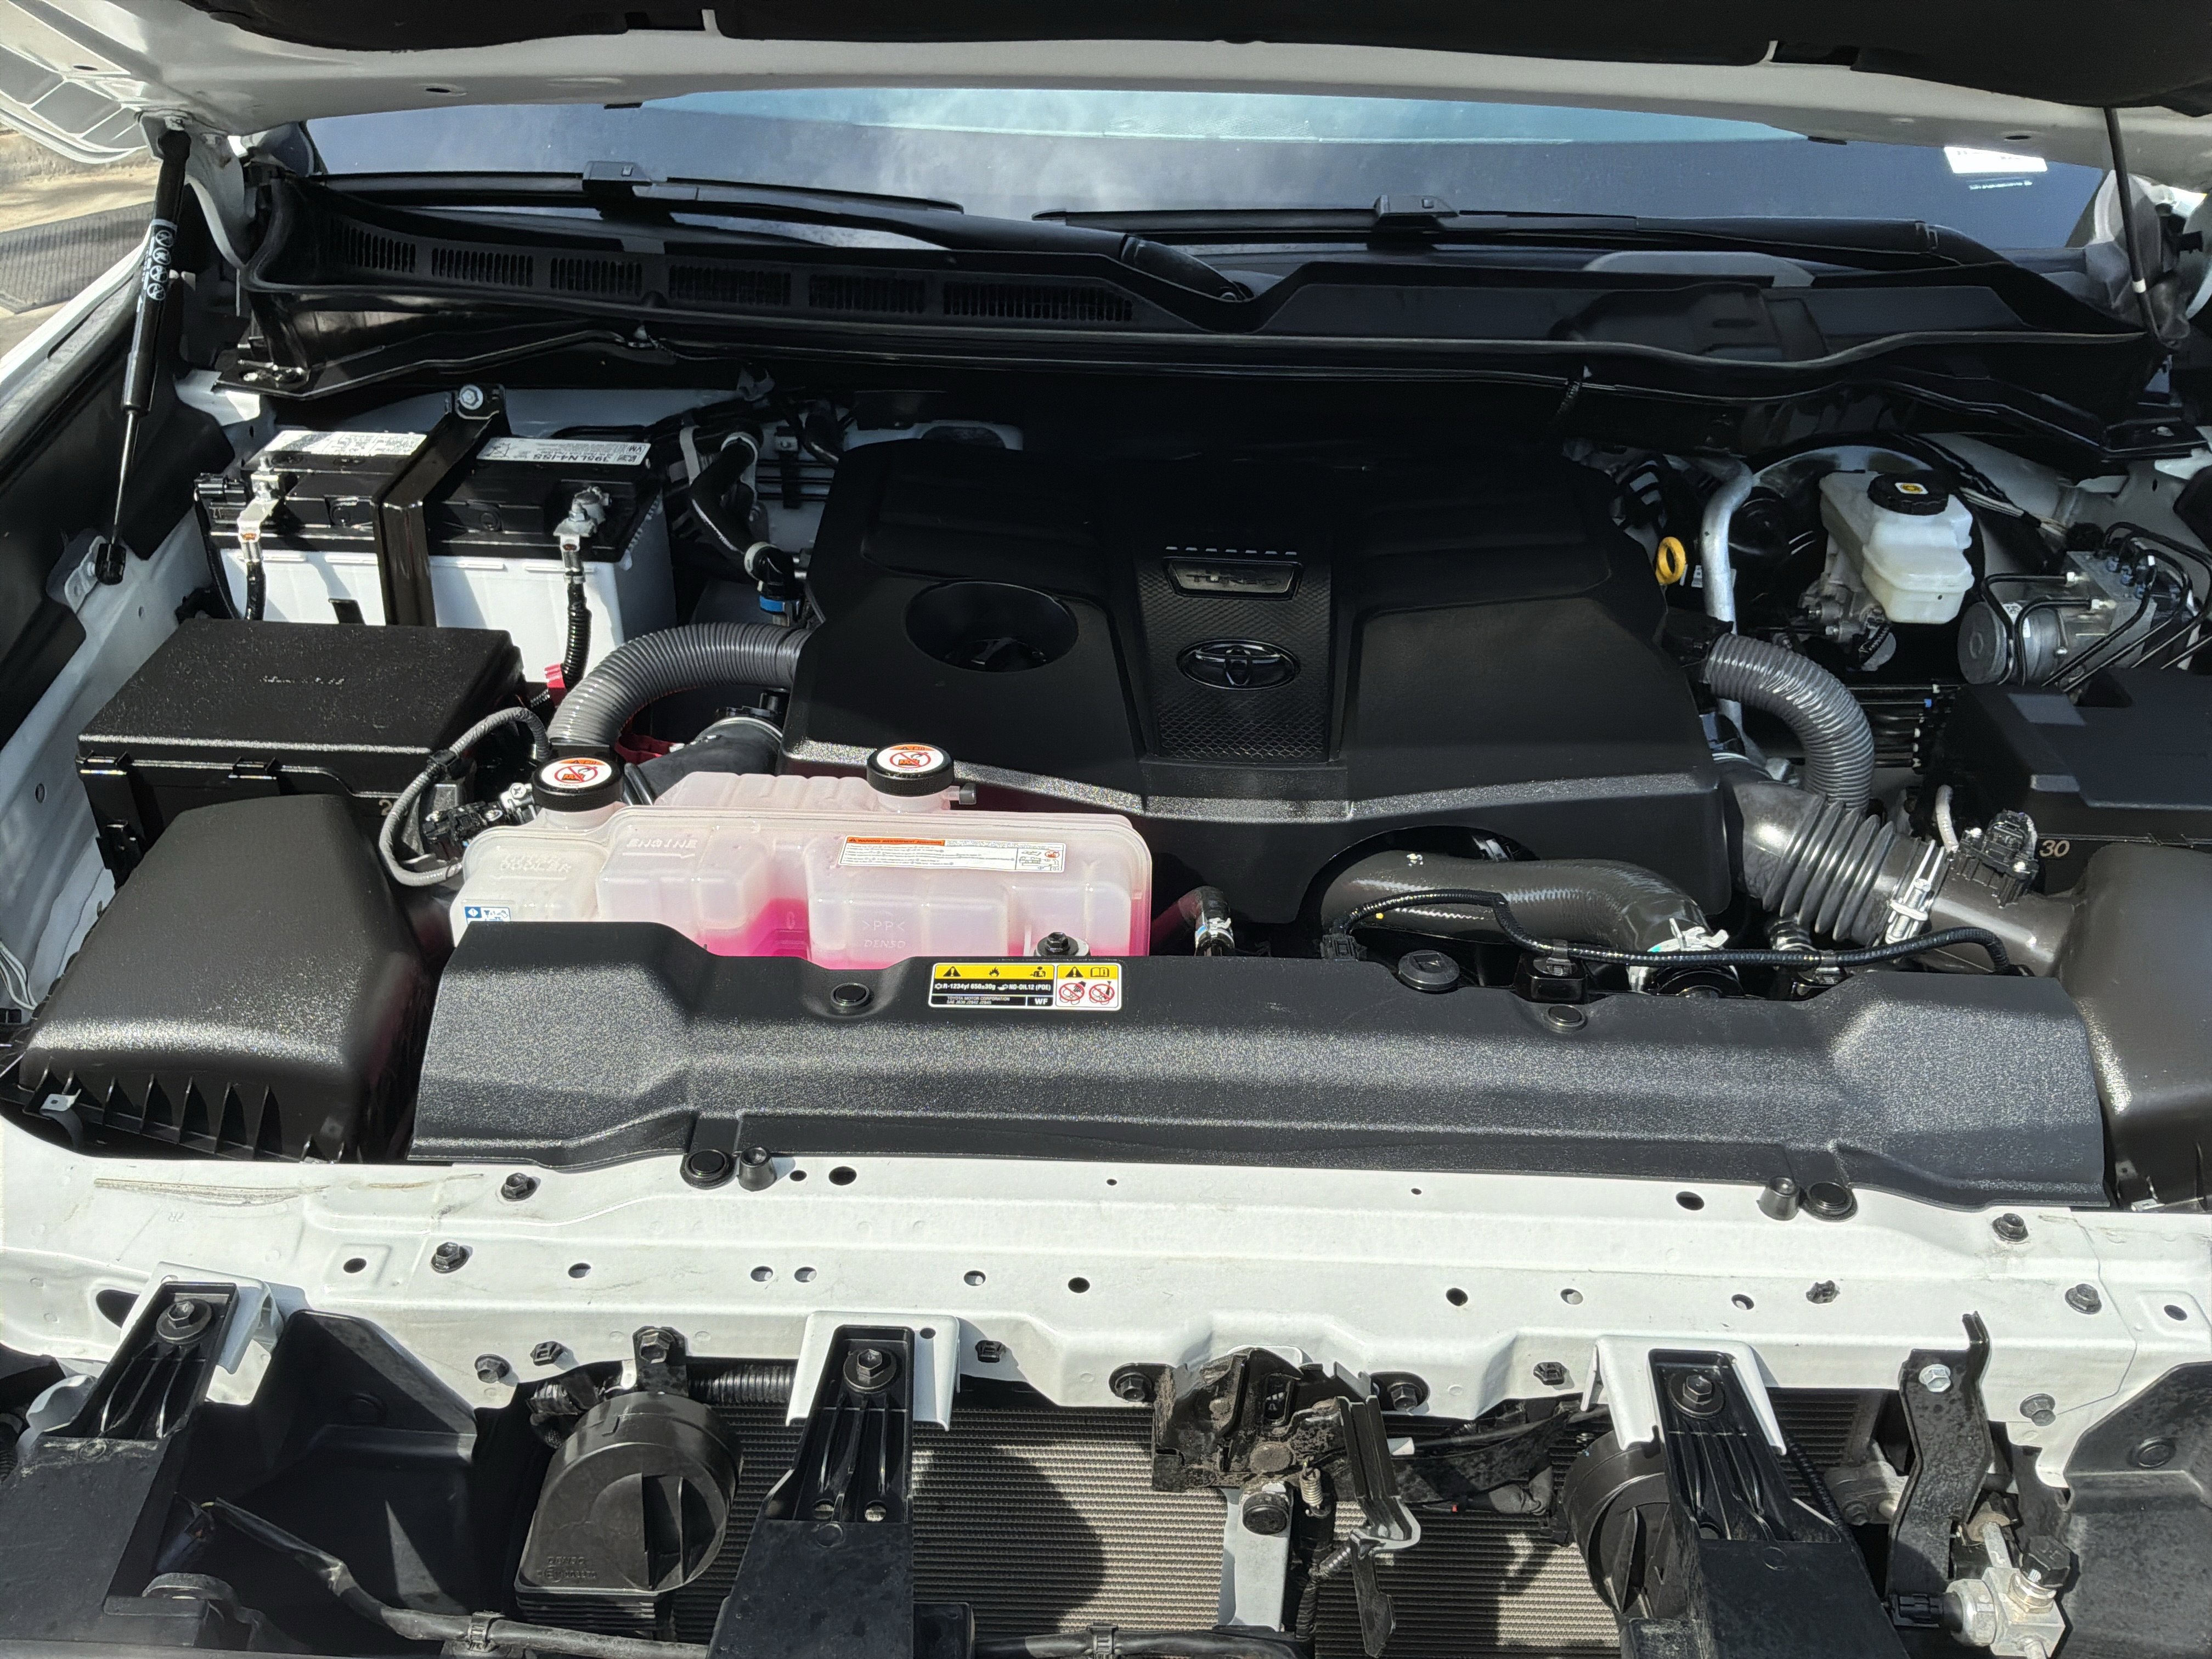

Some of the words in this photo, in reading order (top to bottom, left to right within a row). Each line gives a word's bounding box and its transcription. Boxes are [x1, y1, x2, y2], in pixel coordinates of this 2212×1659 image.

[626, 838, 698, 849] ENGINE
[2039, 839, 2070, 857] 30
[864, 939, 906, 949] DENSO
